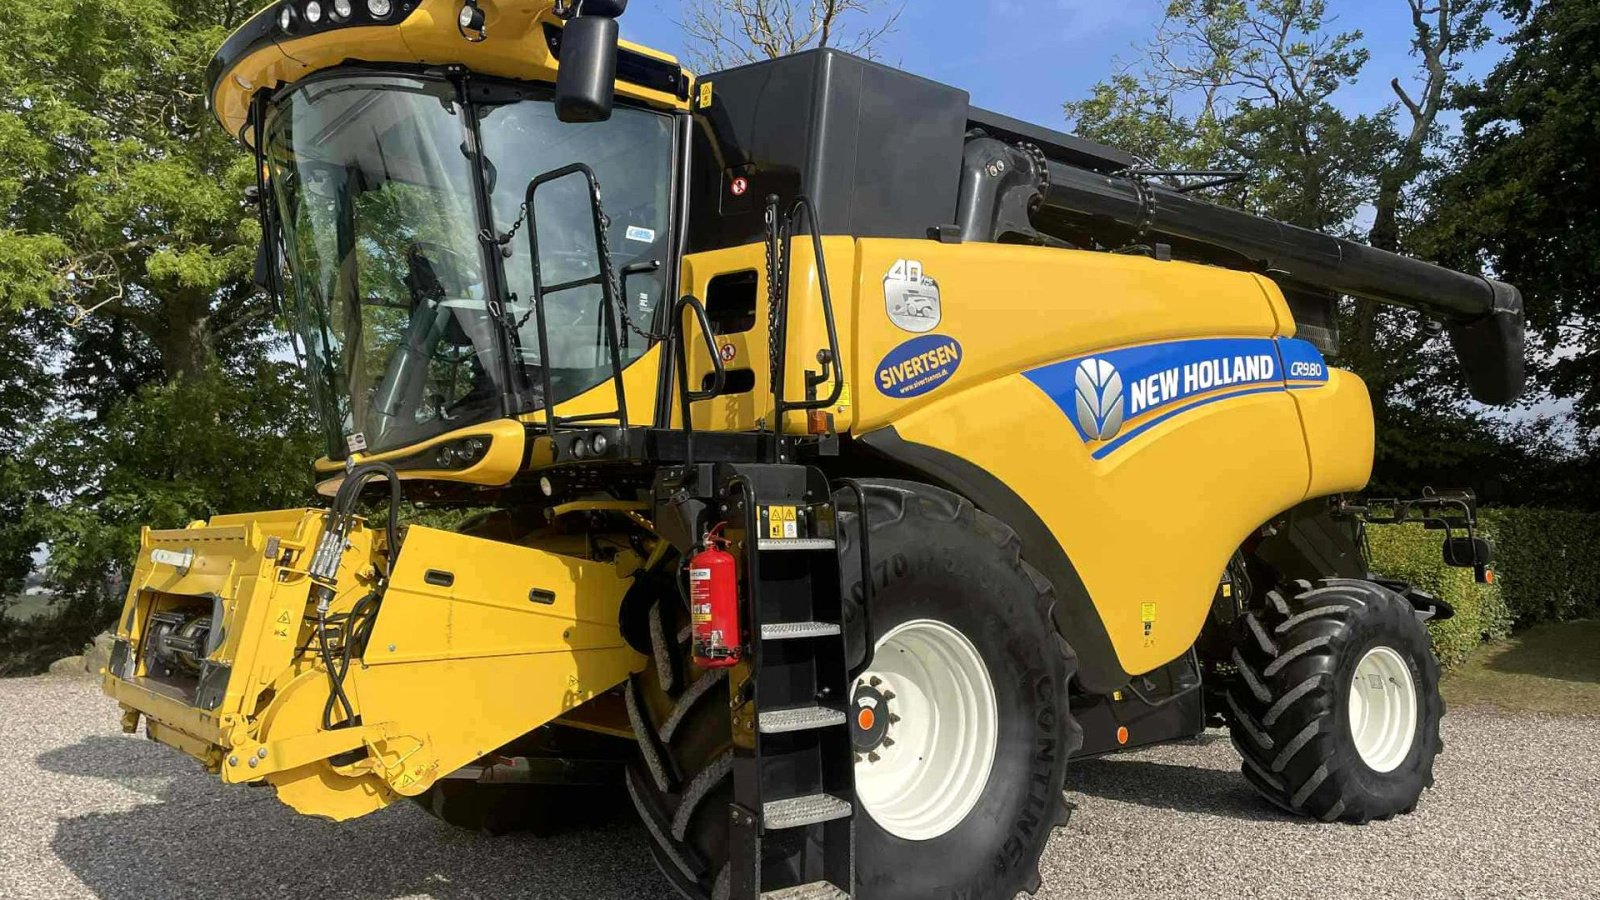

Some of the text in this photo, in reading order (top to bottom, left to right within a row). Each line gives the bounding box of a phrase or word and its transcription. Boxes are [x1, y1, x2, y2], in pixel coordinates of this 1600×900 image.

[887, 258, 922, 281] 40
[880, 341, 958, 390] SIVERTSEN
[1290, 361, 1322, 377] CR9.80
[1131, 355, 1274, 414] NEW HOLLAND
